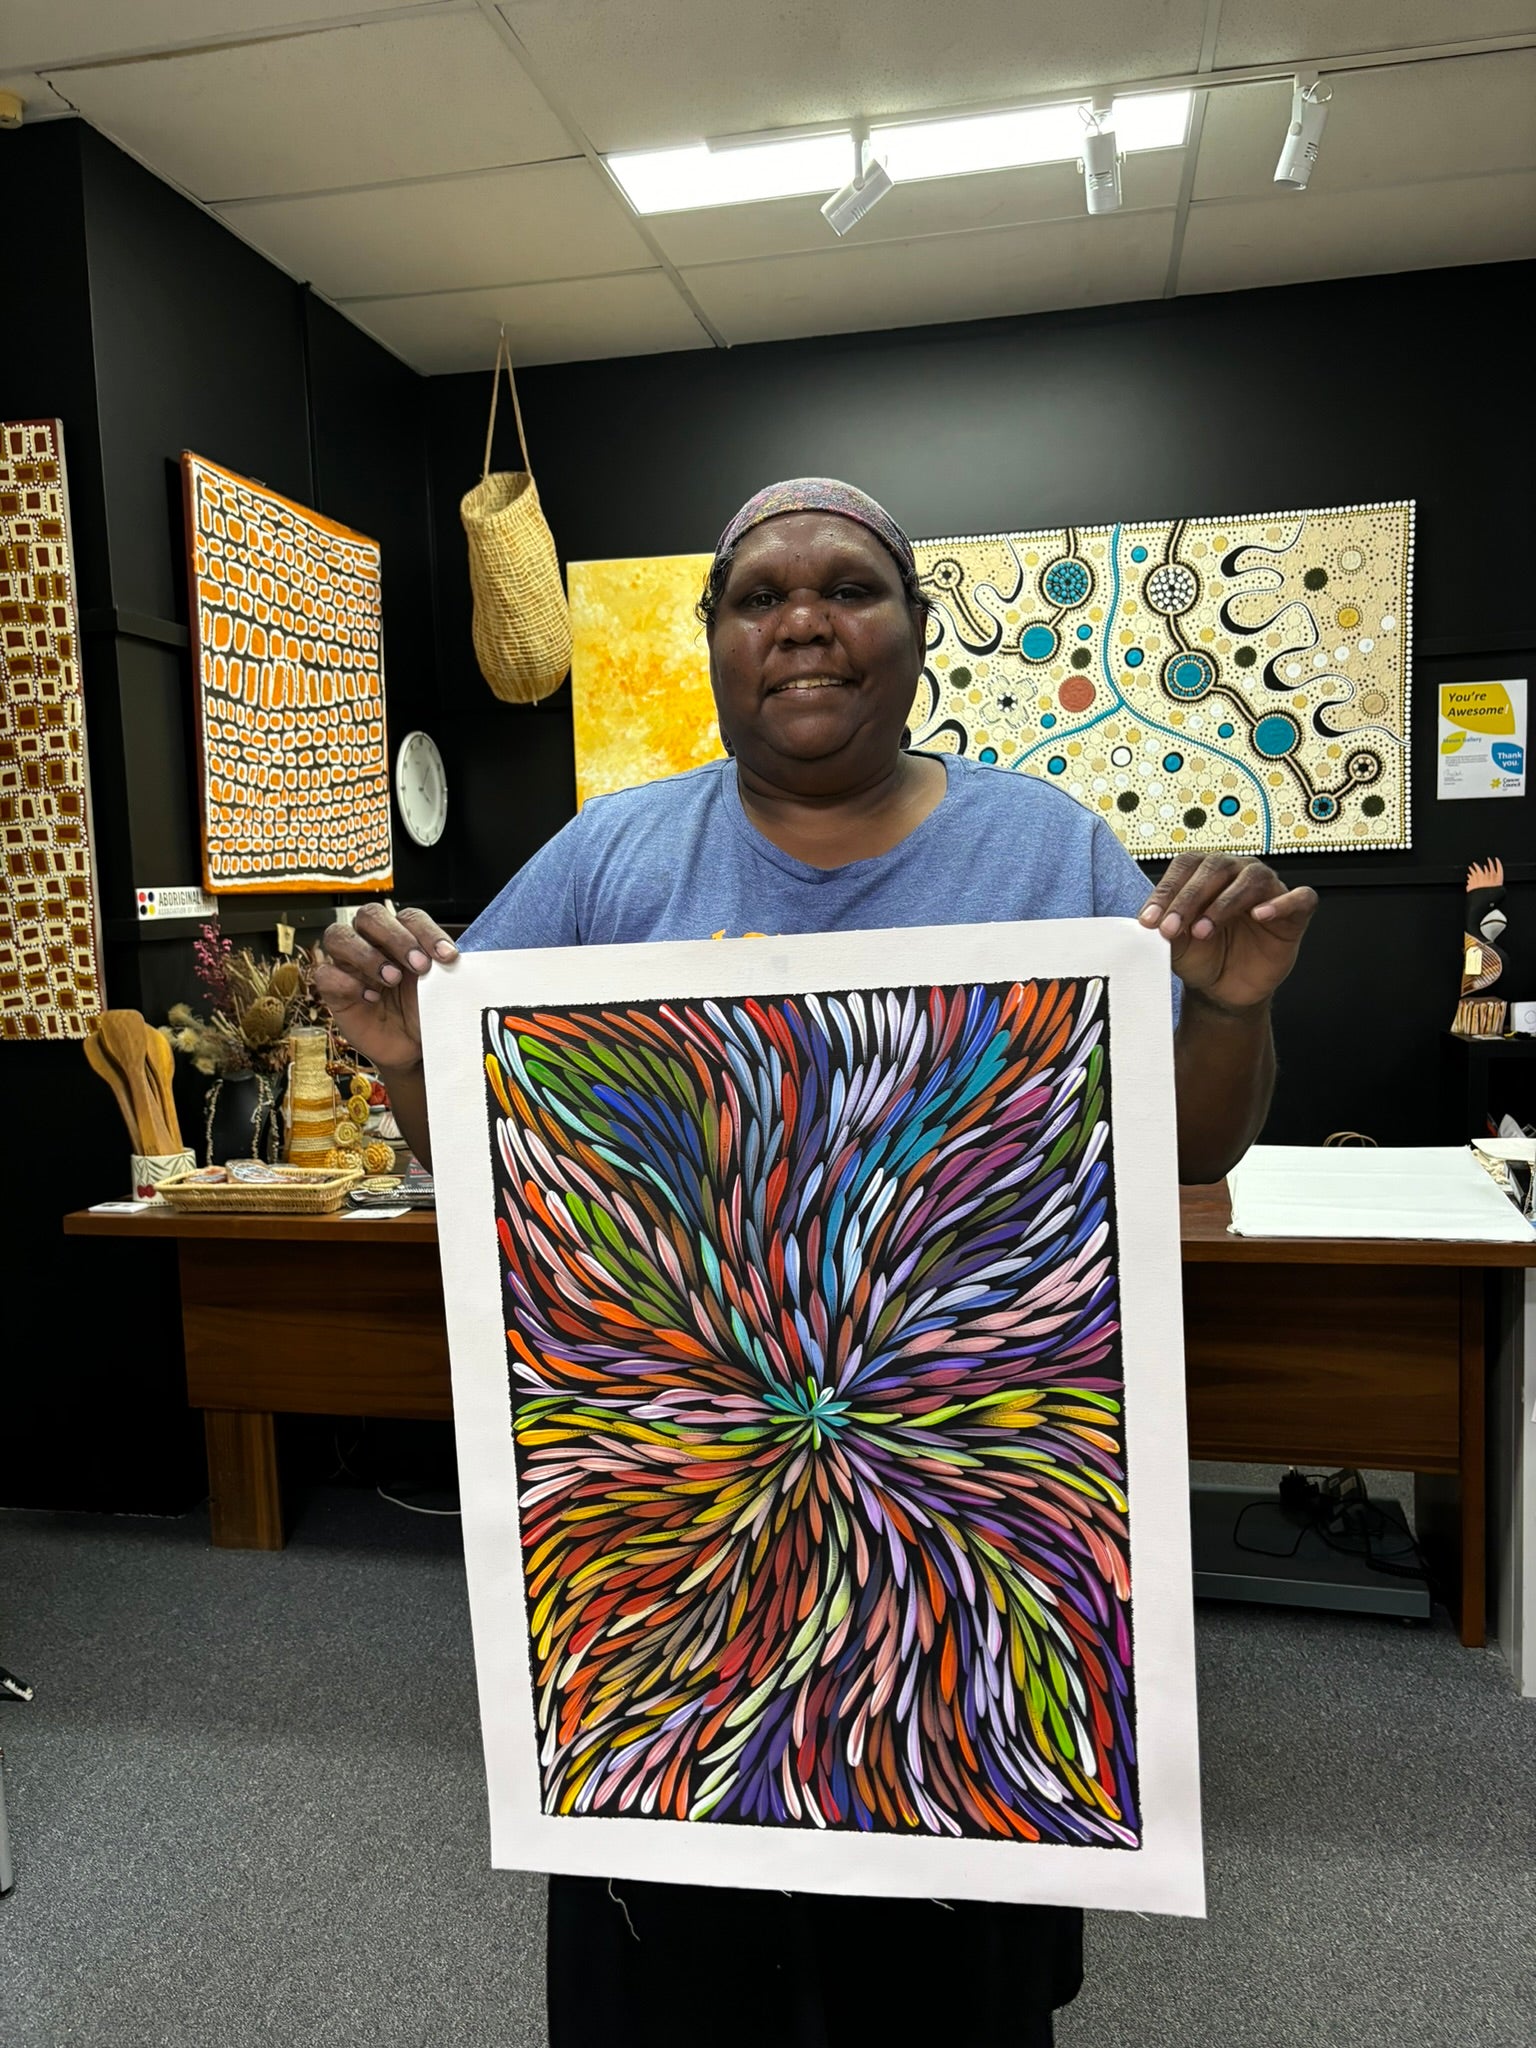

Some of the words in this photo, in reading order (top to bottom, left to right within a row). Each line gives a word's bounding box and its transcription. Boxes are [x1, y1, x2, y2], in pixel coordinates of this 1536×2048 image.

[1449, 691, 1487, 703] You're
[1448, 704, 1509, 717] Awesome!
[159, 891, 201, 906] ABORIGINAL
